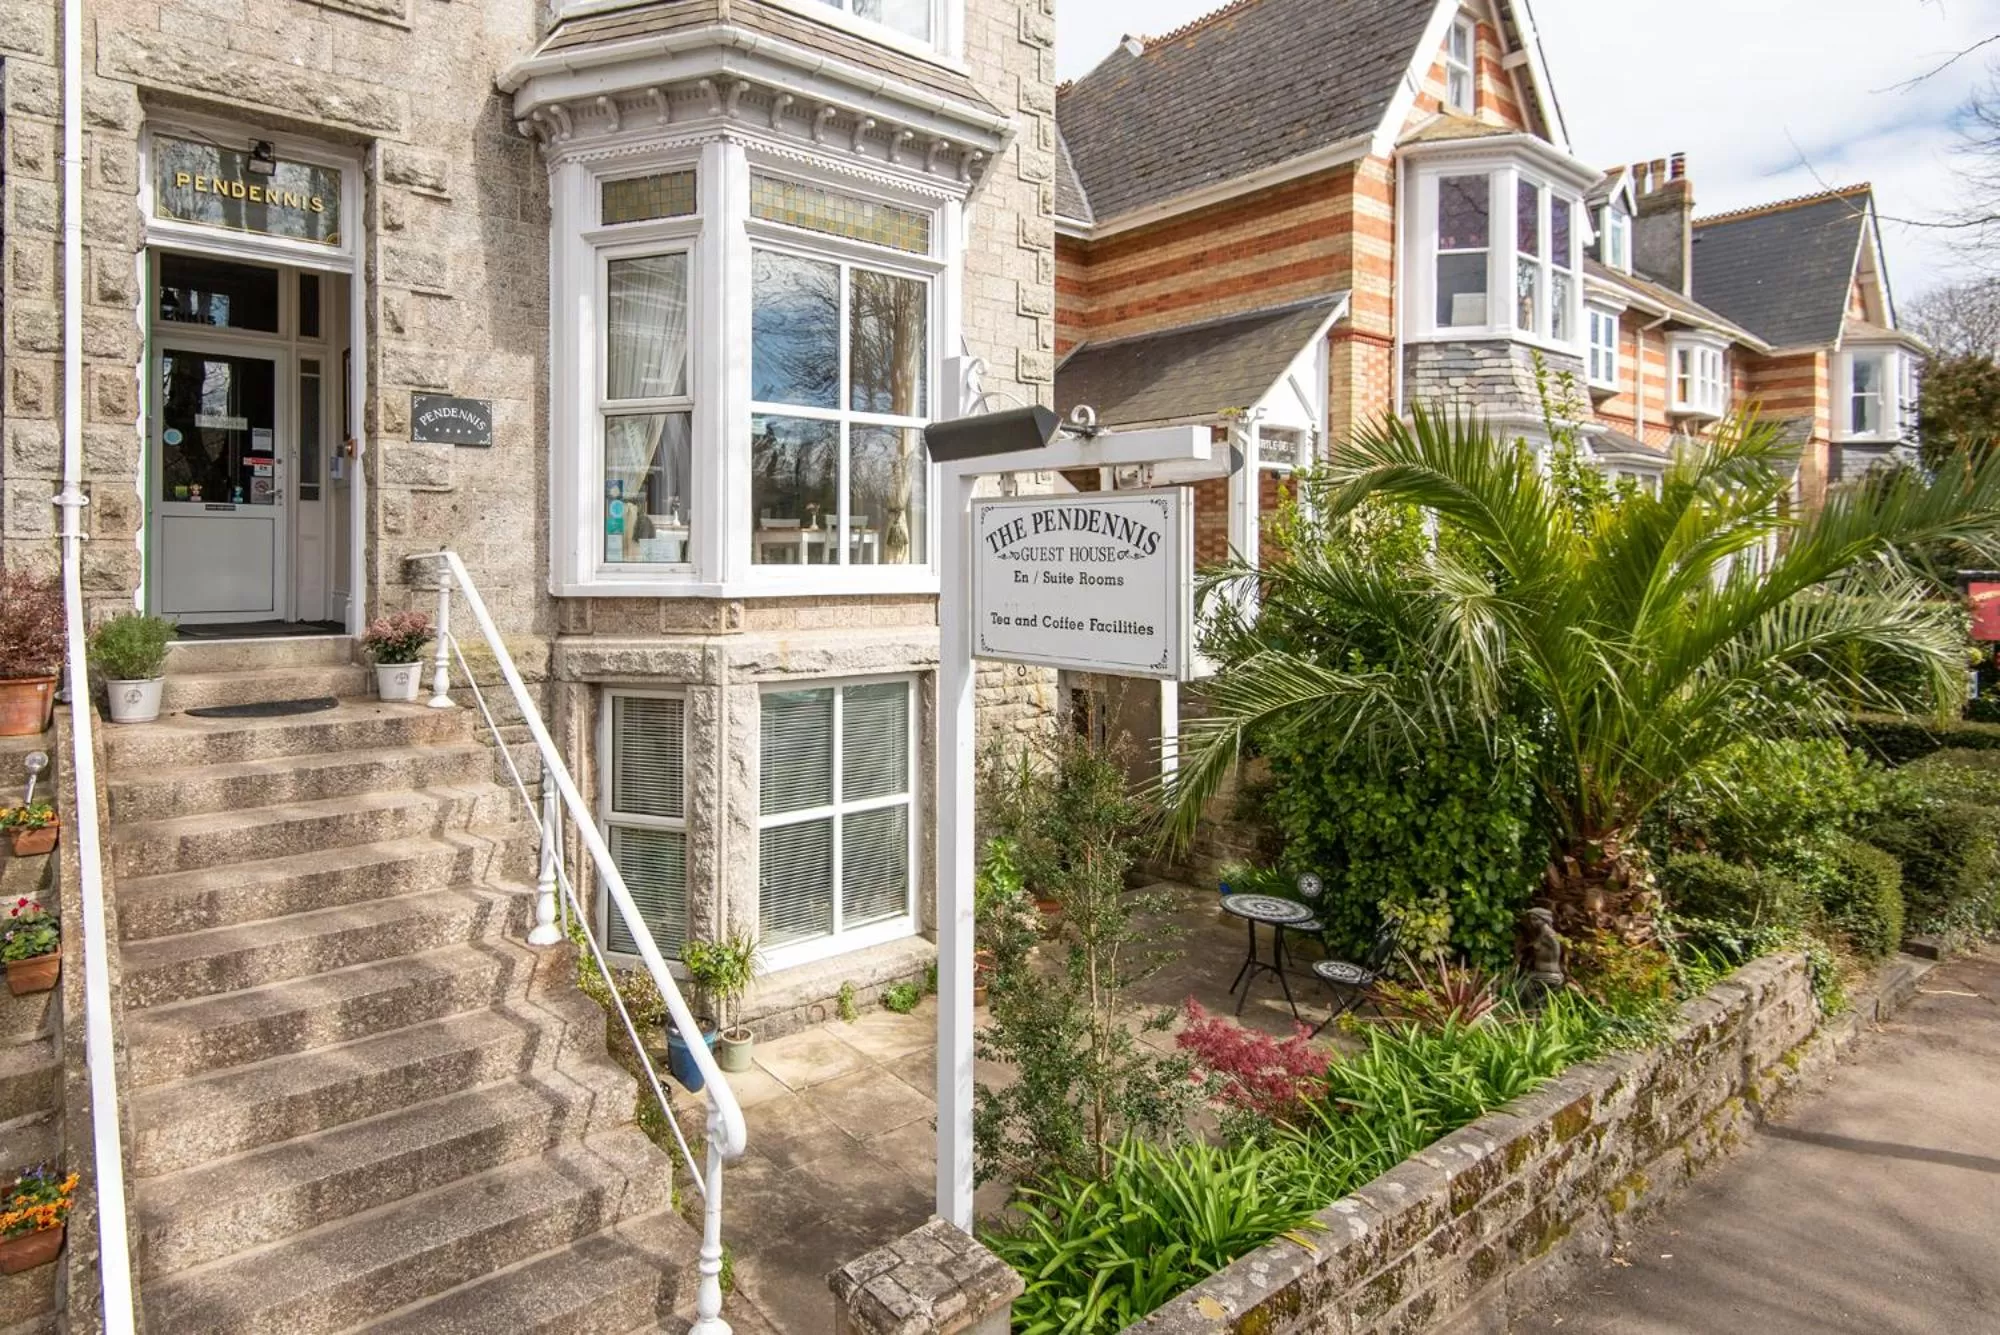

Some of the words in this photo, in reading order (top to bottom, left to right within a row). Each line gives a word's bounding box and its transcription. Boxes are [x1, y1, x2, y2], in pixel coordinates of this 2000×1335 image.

[176, 172, 326, 214] PENDENNIS
[419, 407, 487, 431] PENDENNIS
[986, 517, 1028, 554] THE
[1031, 507, 1162, 556] PENDENNIS
[1020, 546, 1065, 563] GUEST
[1069, 546, 1116, 563] HOUSE
[1013, 569, 1029, 584] En
[1042, 570, 1075, 585] Suite
[1078, 571, 1125, 587] Rooms
[990, 611, 1011, 626] Tea
[1014, 613, 1038, 628] and
[1041, 615, 1085, 631] Coffee
[1088, 617, 1155, 636] Facilities
